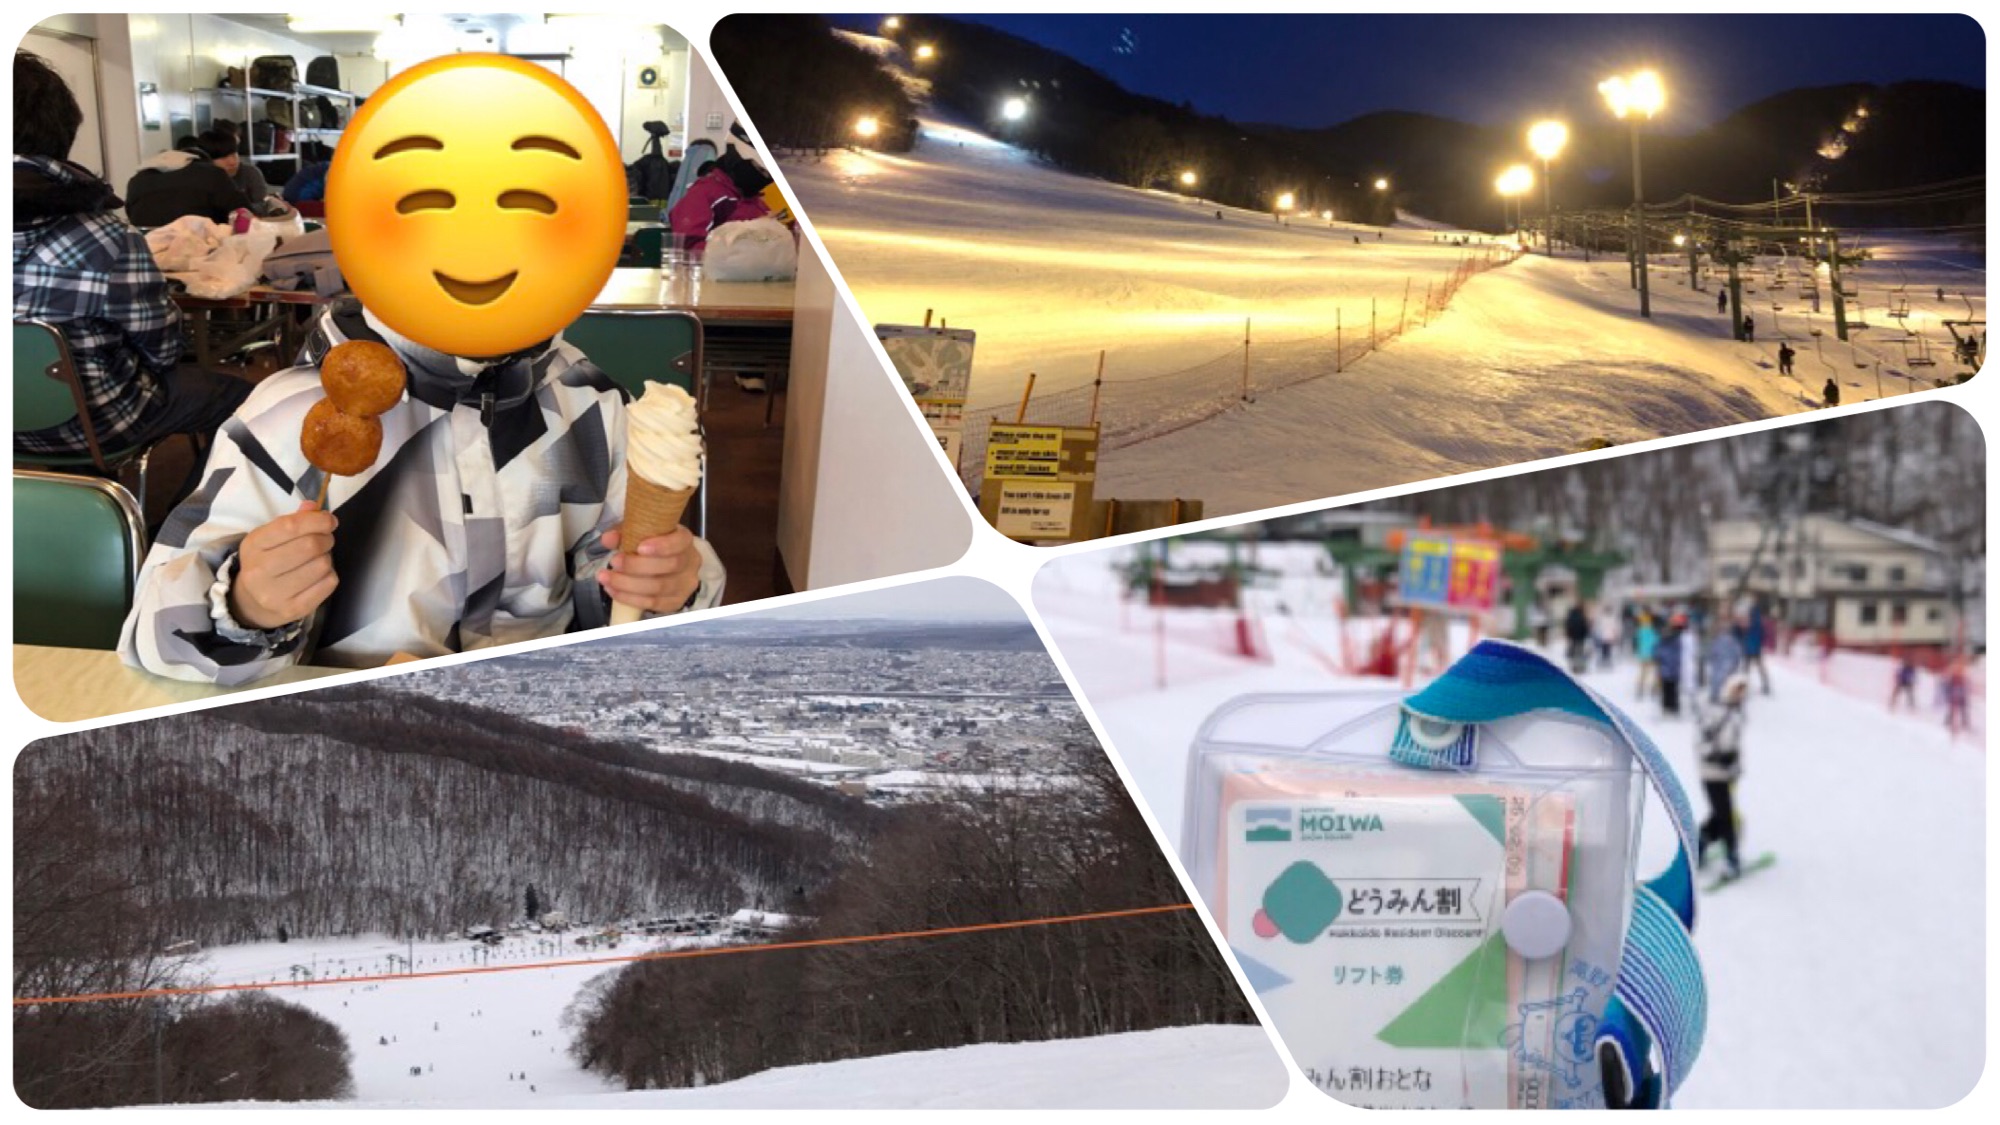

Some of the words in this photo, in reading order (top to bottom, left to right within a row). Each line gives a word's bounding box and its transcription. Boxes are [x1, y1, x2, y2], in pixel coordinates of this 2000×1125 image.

[1301, 814, 1383, 832] MOIWA
[1348, 886, 1461, 915] どうみん割
[1383, 927, 1432, 938] Resident
[1334, 965, 1404, 985] リフト券
